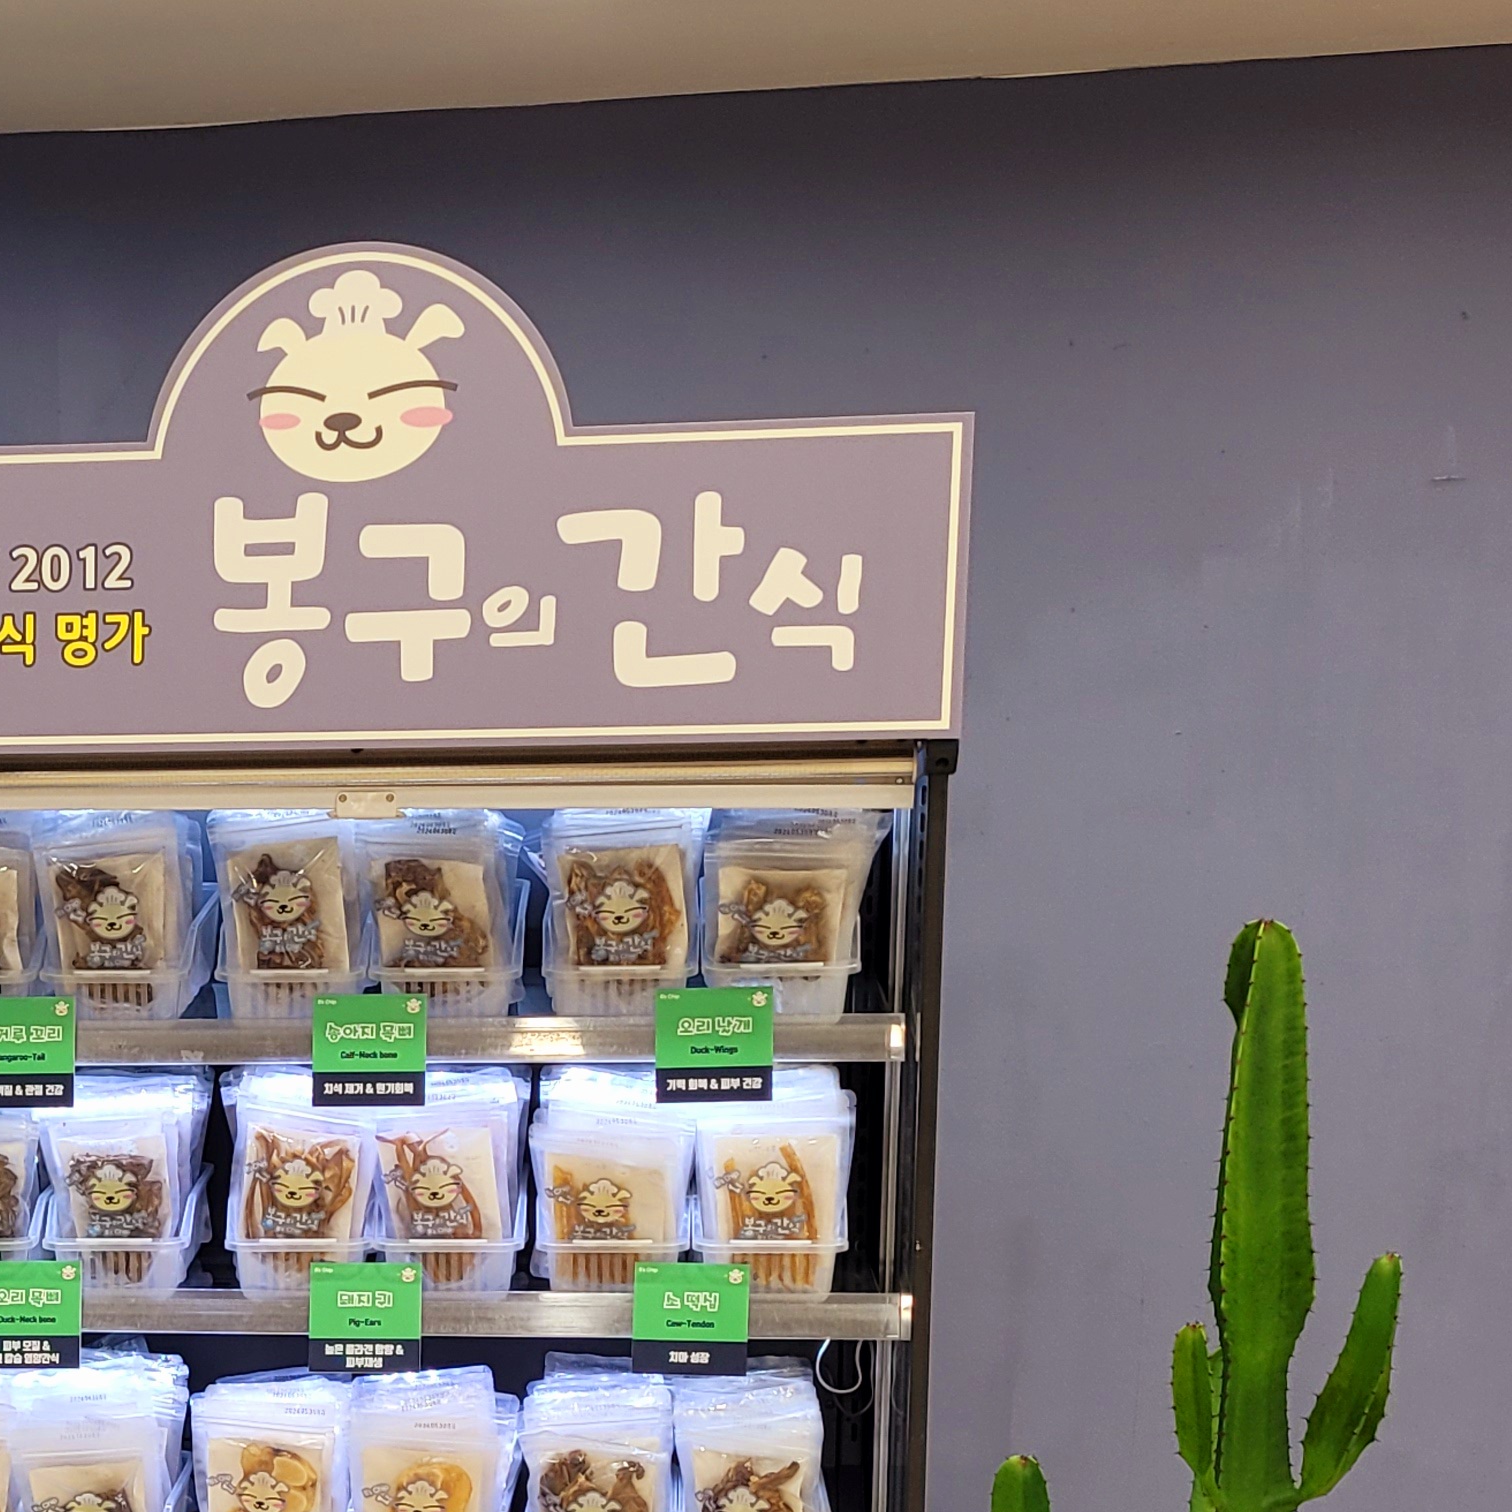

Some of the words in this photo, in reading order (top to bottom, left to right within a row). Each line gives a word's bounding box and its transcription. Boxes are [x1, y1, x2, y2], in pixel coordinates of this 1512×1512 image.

[8, 542, 133, 592] 2012
[213, 493, 556, 710] 봉구의
[557, 491, 862, 687] 간식
[55, 612, 151, 667] 명가
[30, 1025, 62, 1042] 꼬리
[326, 1022, 376, 1043] 송아지
[380, 1022, 413, 1042] 목뼈
[677, 1018, 712, 1035] 오리
[715, 1017, 752, 1036] 날개
[29, 1289, 61, 1307] 목뼈
[338, 1291, 372, 1307] 돼지
[375, 1291, 393, 1308] 귀
[663, 1292, 681, 1308] 소
